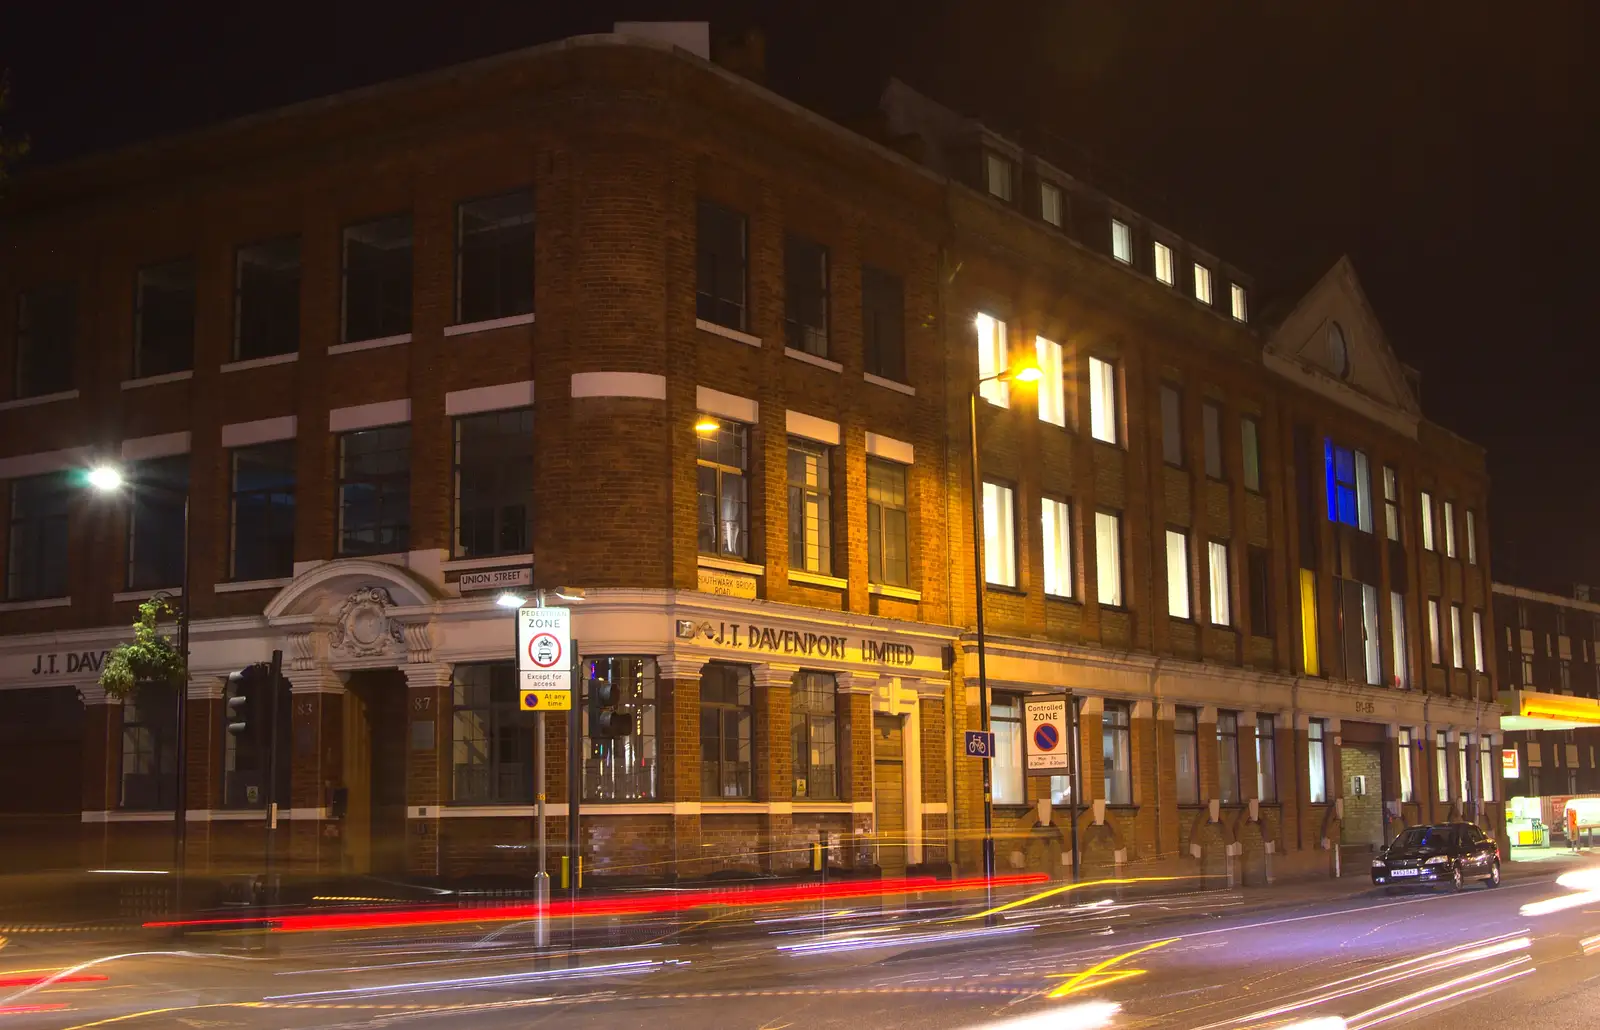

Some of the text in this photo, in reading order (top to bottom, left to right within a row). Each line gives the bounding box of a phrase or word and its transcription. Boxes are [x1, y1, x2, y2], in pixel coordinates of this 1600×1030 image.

[462, 574, 490, 584] UNION
[494, 571, 520, 581] STREET
[714, 586, 731, 596] ROAD
[528, 619, 560, 628] ZONE
[748, 625, 847, 660] DAVENPORT
[861, 639, 915, 665] LIMITED
[414, 697, 431, 711] 87
[1028, 704, 1063, 712] Controlled
[1033, 713, 1058, 721] ZONE
